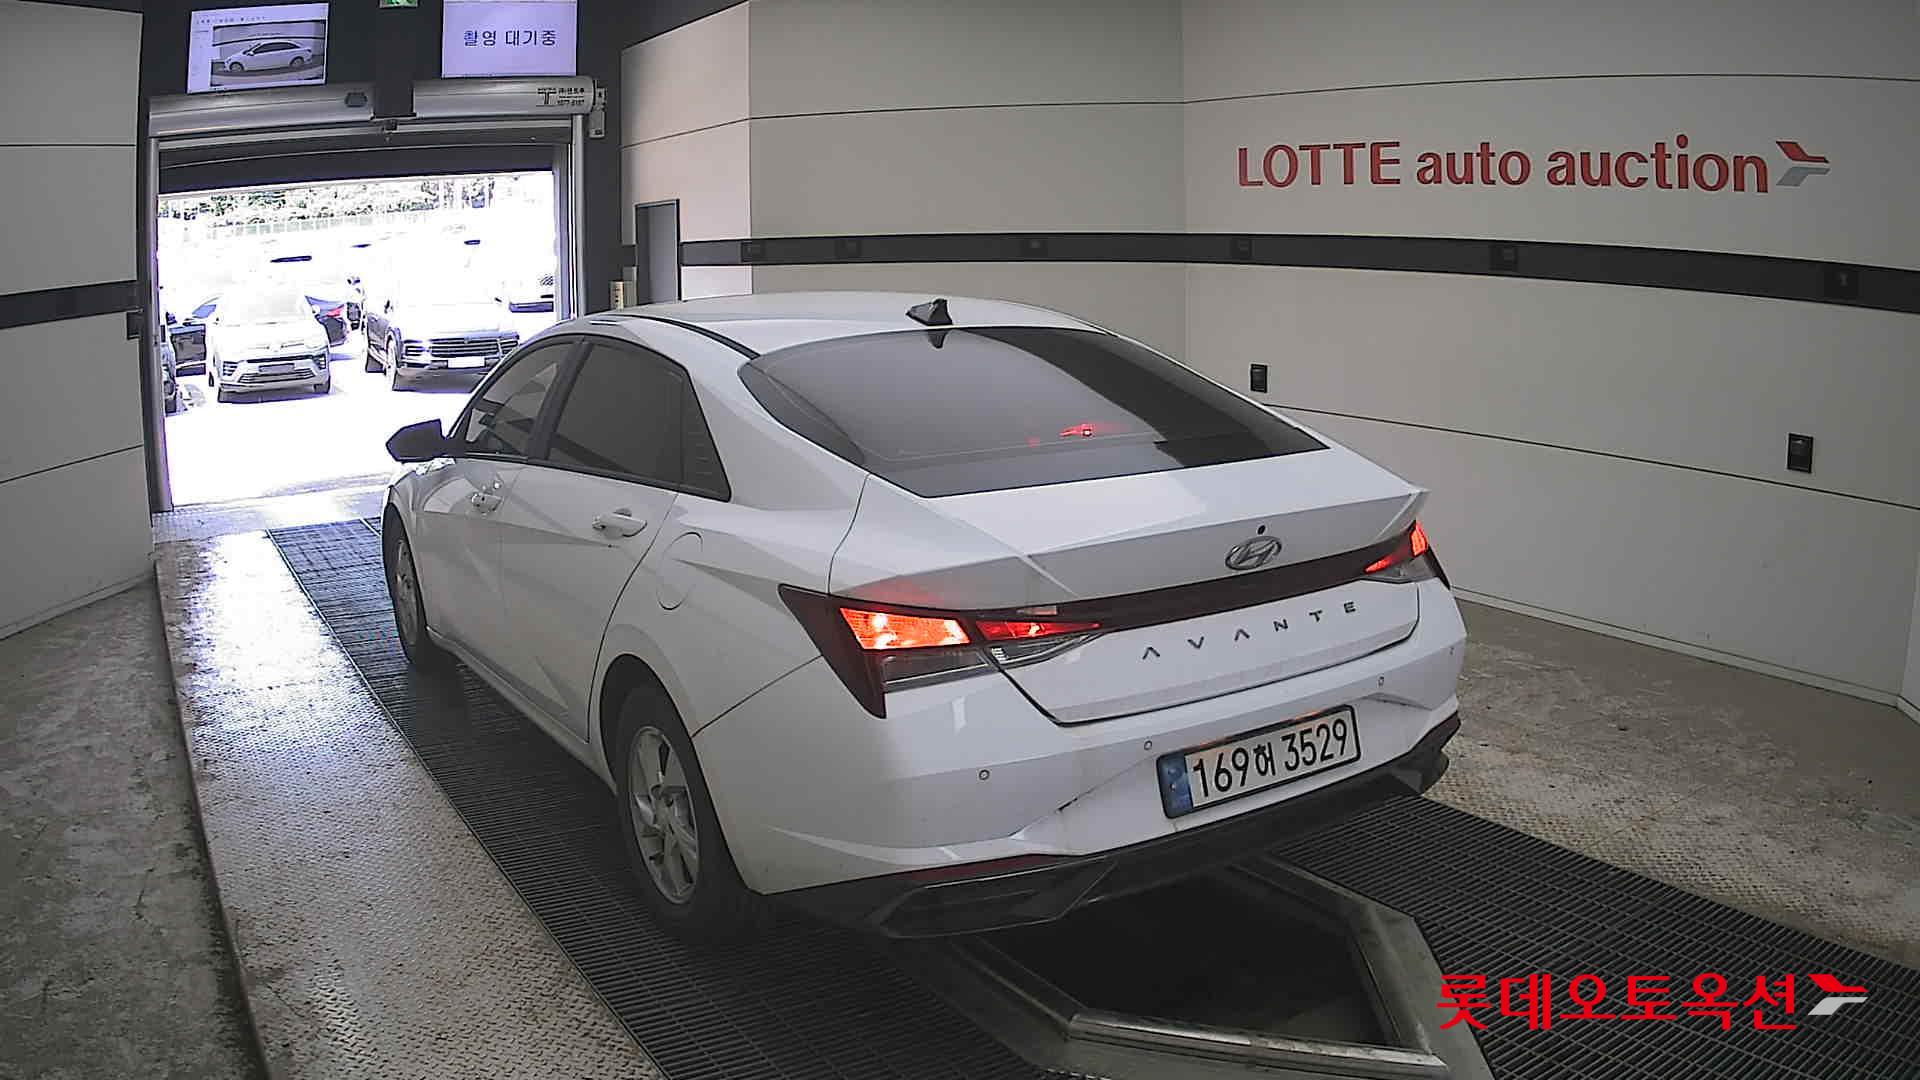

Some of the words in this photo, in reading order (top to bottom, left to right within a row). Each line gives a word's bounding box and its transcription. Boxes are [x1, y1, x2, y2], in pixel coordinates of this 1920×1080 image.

[505, 30, 557, 47] 대기중
[1238, 141, 1401, 188] LOTTE
[1416, 142, 1531, 186] auto
[1547, 134, 1768, 193] auction
[1142, 601, 1357, 661] AVANTE
[1193, 742, 1276, 798] 169허
[1281, 718, 1348, 772] 3529
